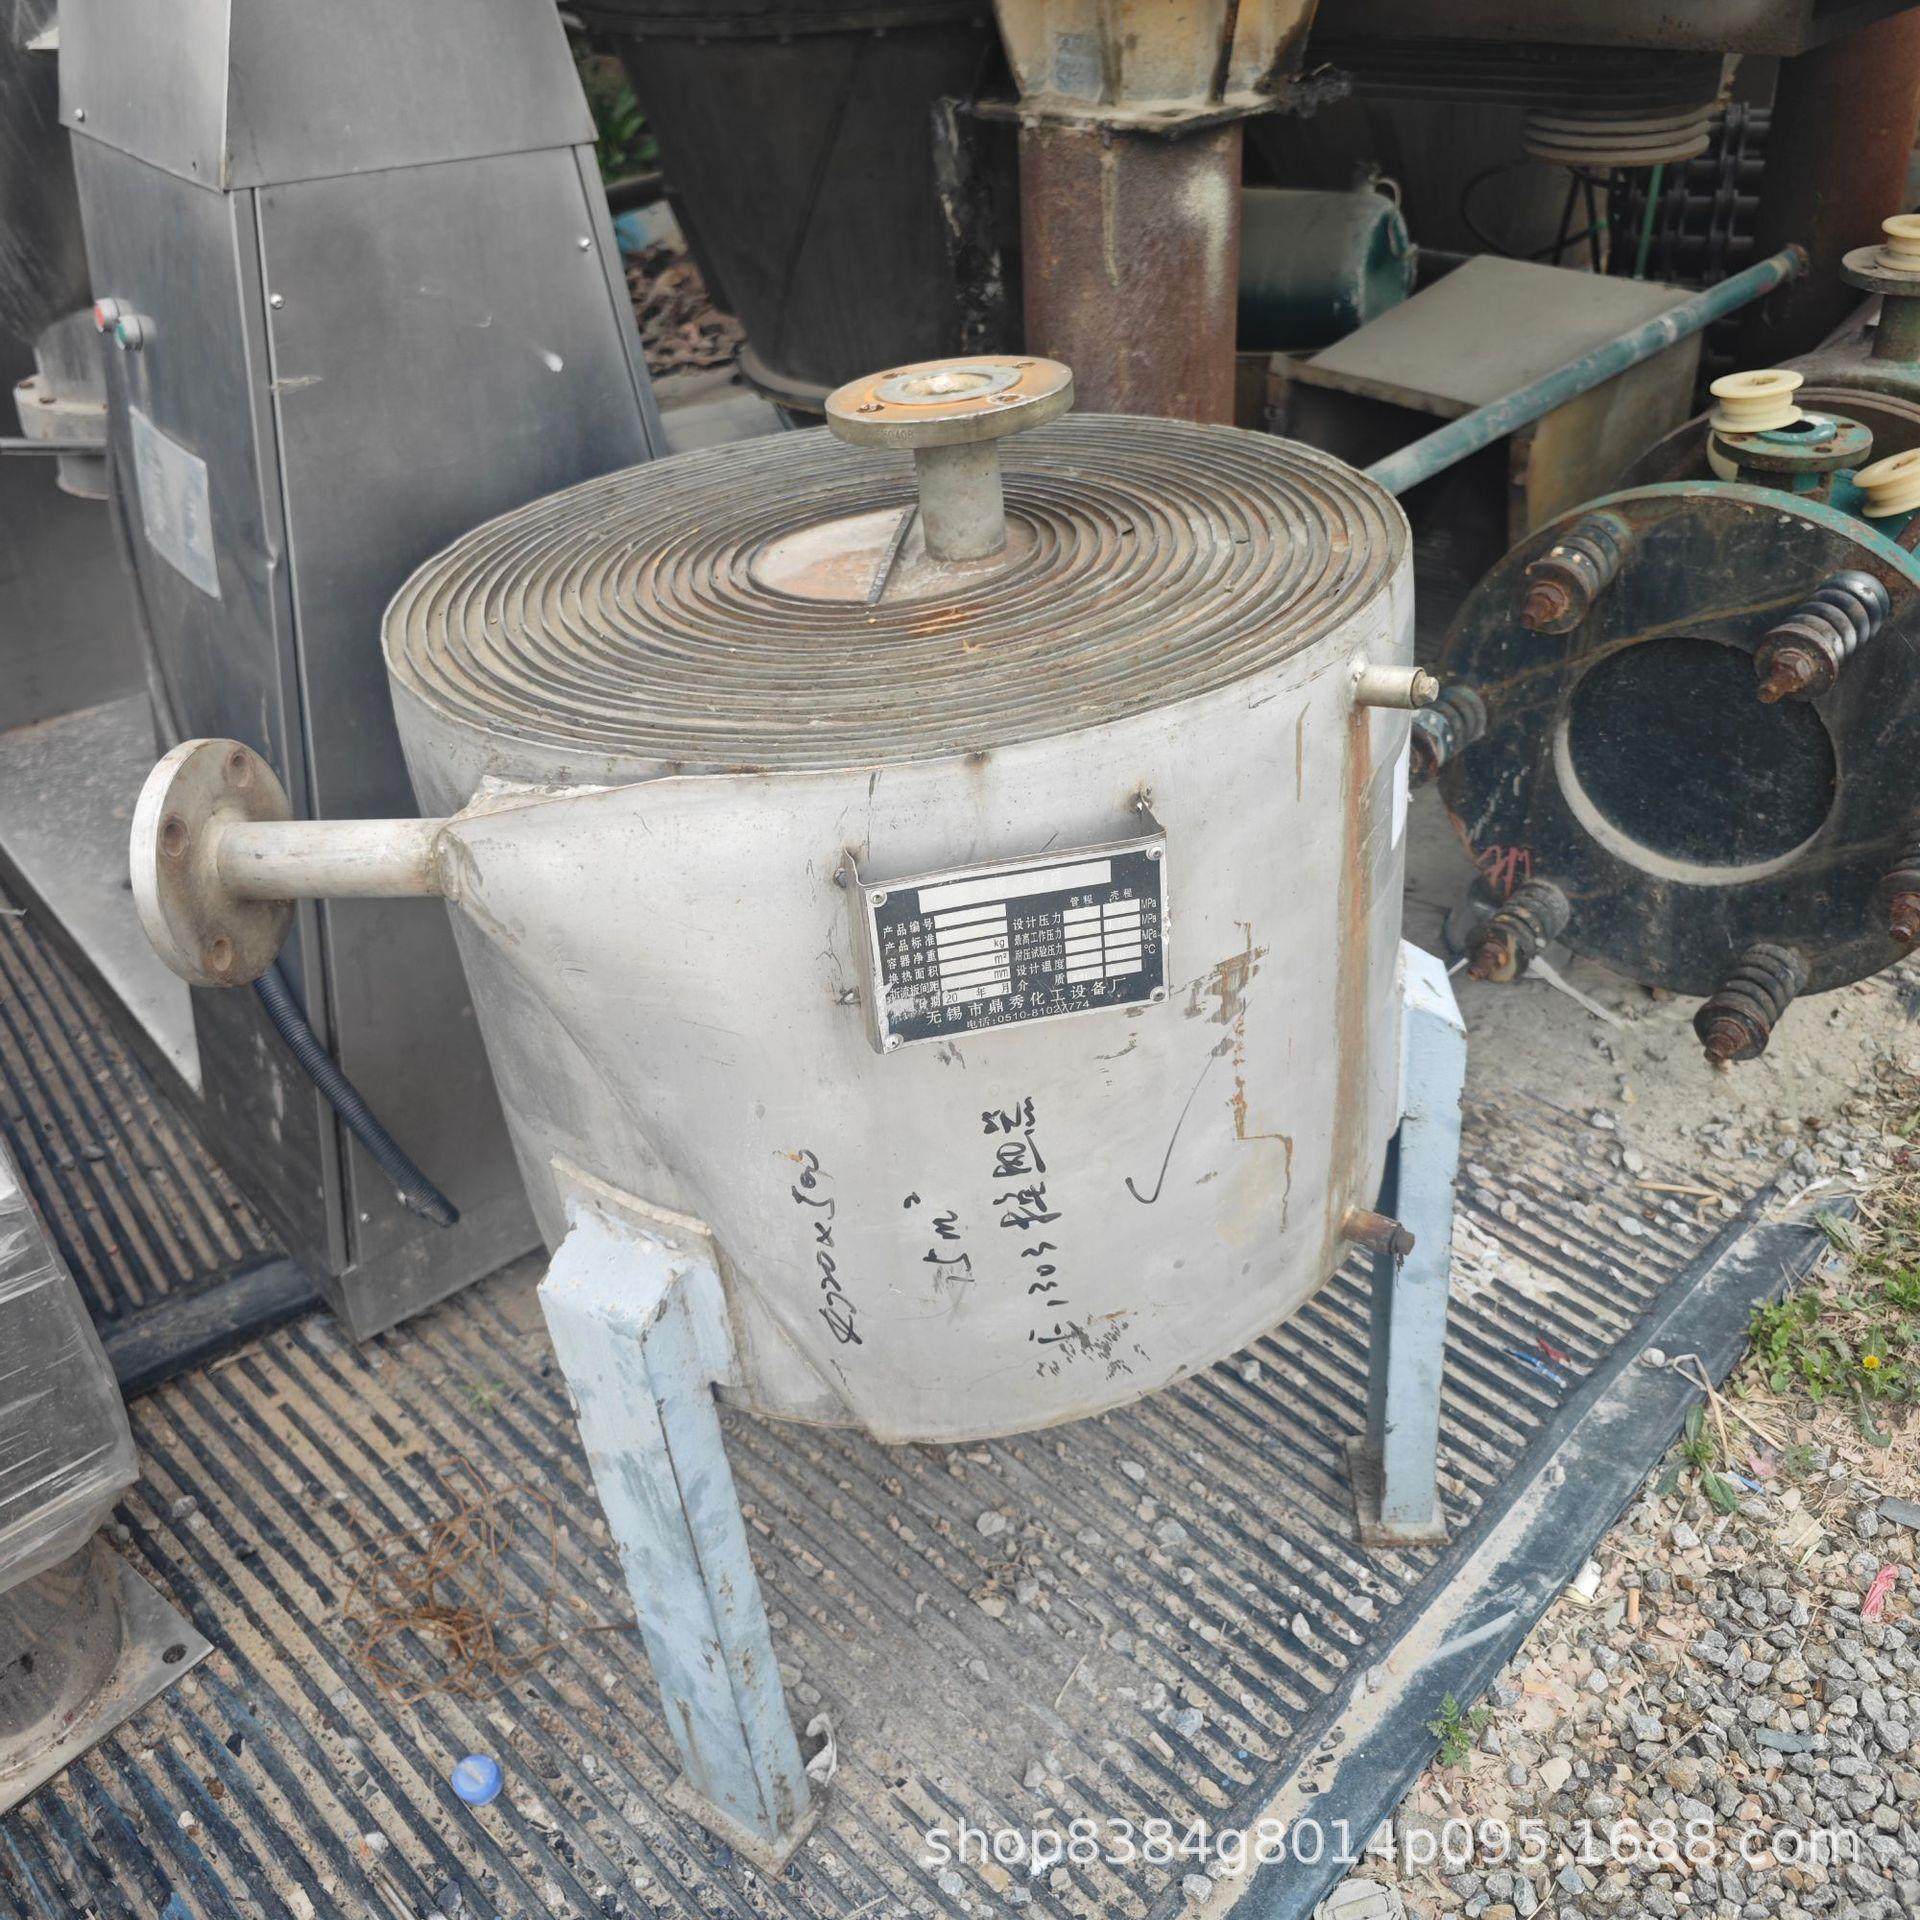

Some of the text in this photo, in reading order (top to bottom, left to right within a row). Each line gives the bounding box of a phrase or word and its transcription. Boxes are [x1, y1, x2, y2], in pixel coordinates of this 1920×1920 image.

[1141, 898, 1157, 909] MPa
[1013, 913, 1061, 930] 设计压力
[1141, 913, 1157, 924] MPa
[883, 919, 934, 938] 产品编号
[1014, 929, 1062, 945] 最高工作压力
[885, 935, 936, 954] 产品标准
[994, 938, 1005, 949] kg
[887, 950, 937, 969] 容器净重
[1015, 944, 1063, 961] 耐压试验压力
[889, 967, 938, 985] 换热面积
[994, 968, 1009, 979] mm
[1016, 959, 1065, 976] 设计温度
[926, 977, 1126, 1025] 无锡市鼎秀化工设备厂
